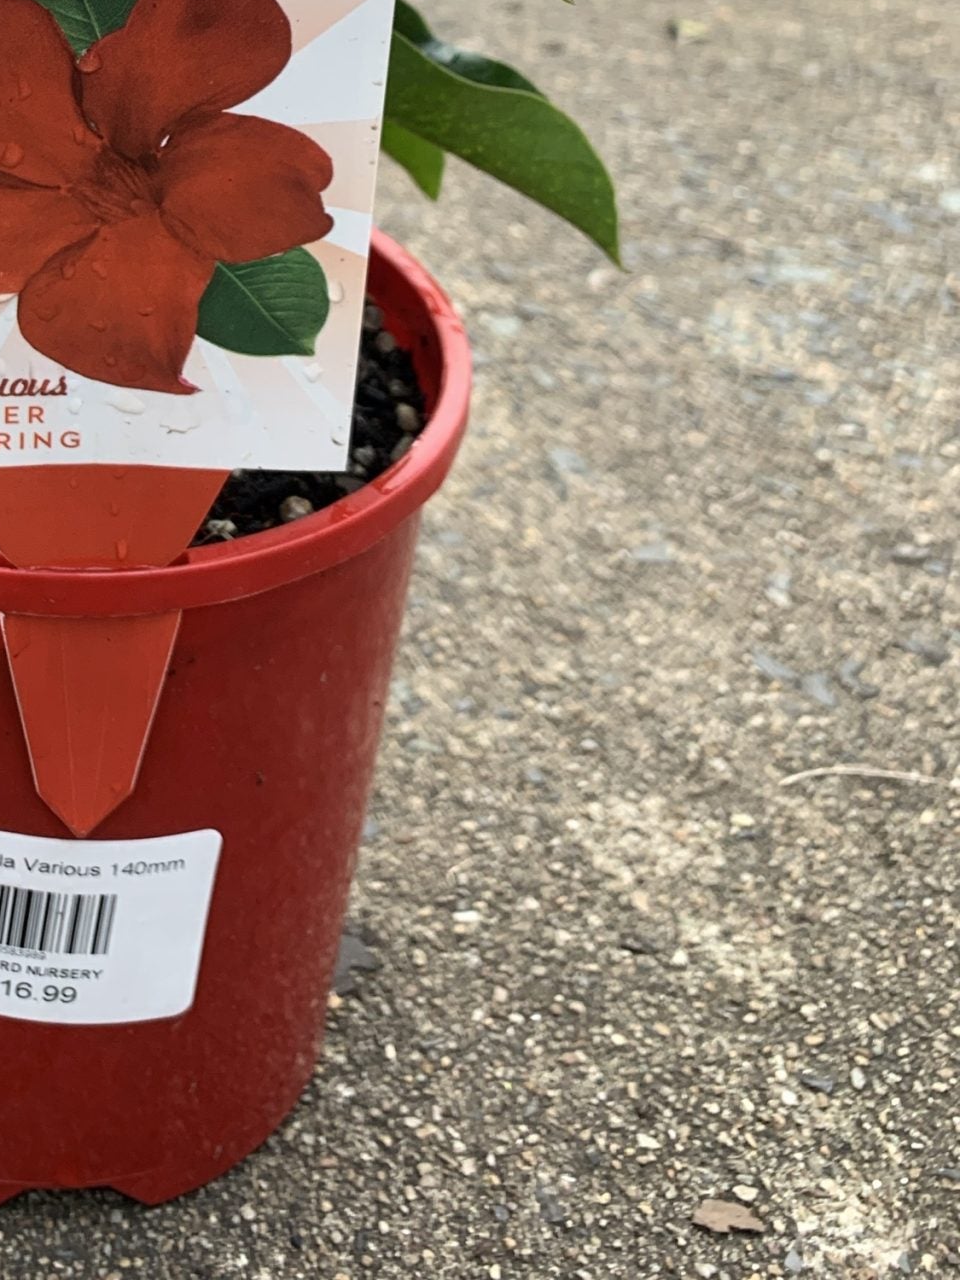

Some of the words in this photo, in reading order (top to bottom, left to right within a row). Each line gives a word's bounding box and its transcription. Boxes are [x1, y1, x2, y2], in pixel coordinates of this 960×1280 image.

[23, 857, 101, 877] Various
[110, 857, 186, 876] 140mm
[25, 964, 103, 981] NURSERY
